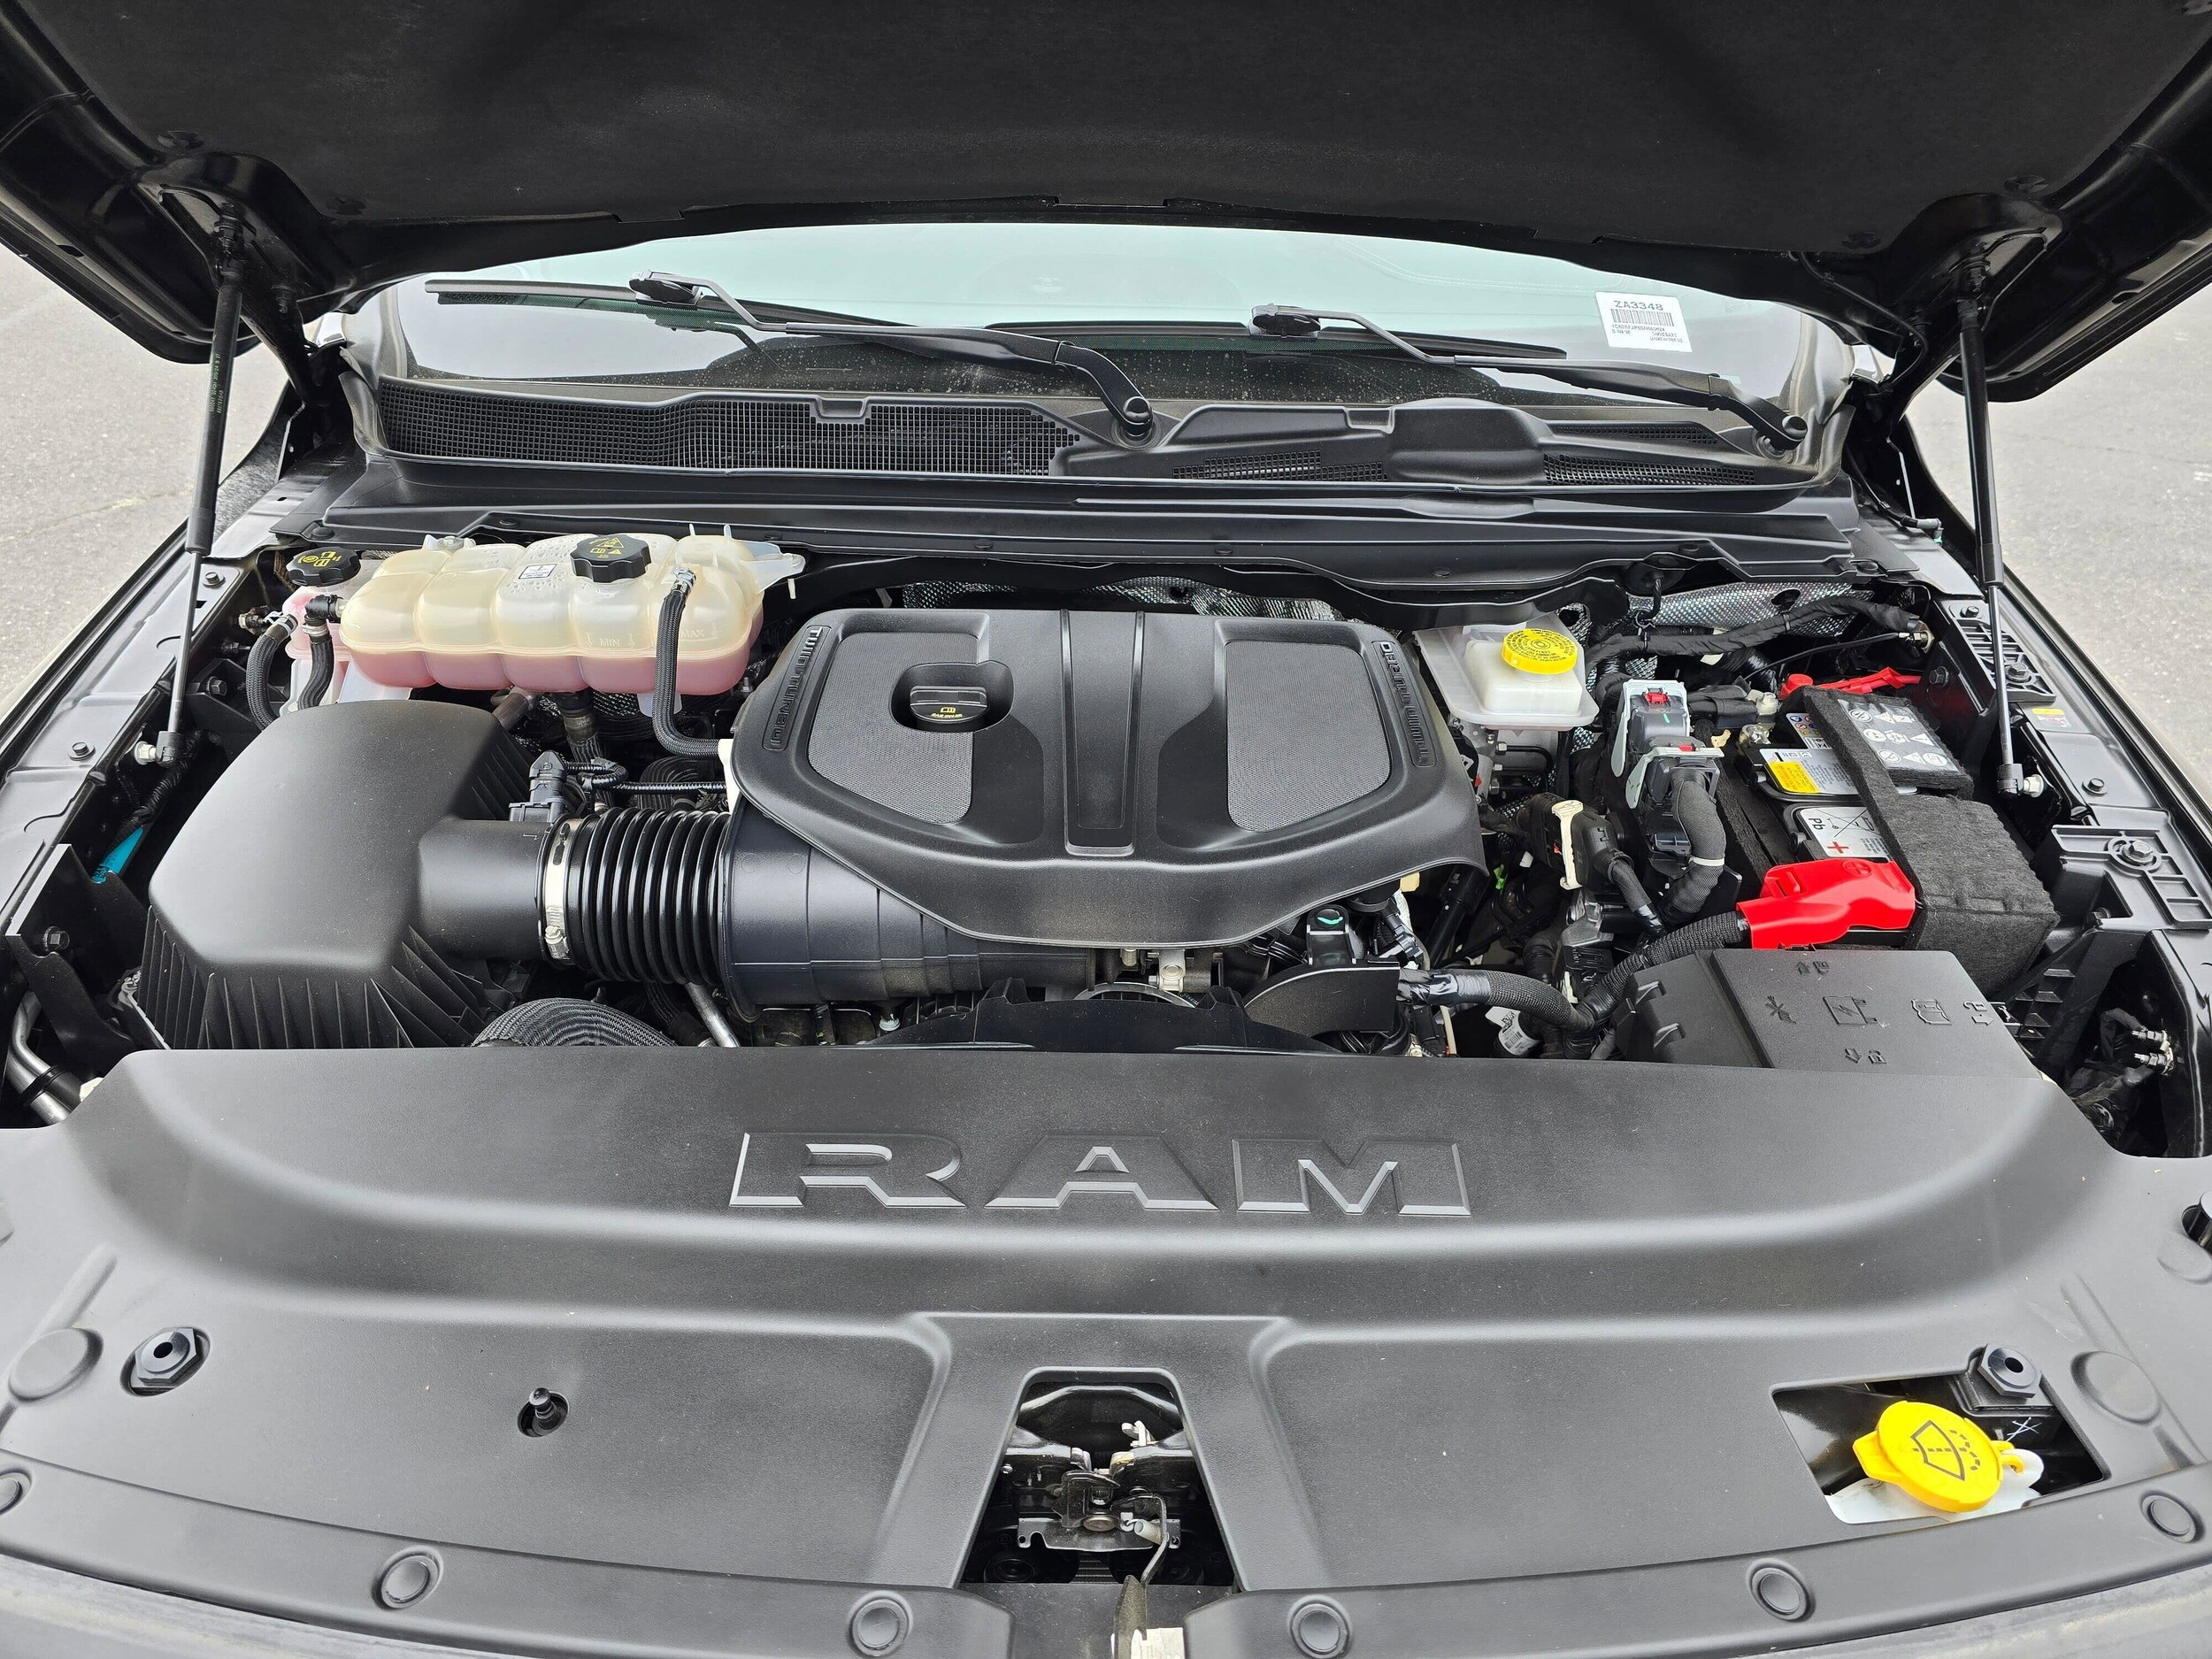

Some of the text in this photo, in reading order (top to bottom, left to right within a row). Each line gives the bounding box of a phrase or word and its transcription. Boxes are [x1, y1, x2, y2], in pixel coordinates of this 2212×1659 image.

[1613, 300, 1663, 311] ZA3348
[770, 626, 824, 747] TWIN TURBO
[1379, 641, 1429, 763] TWIN TURBO
[1808, 818, 1825, 830] Pb
[729, 1132, 1472, 1217] RAM
